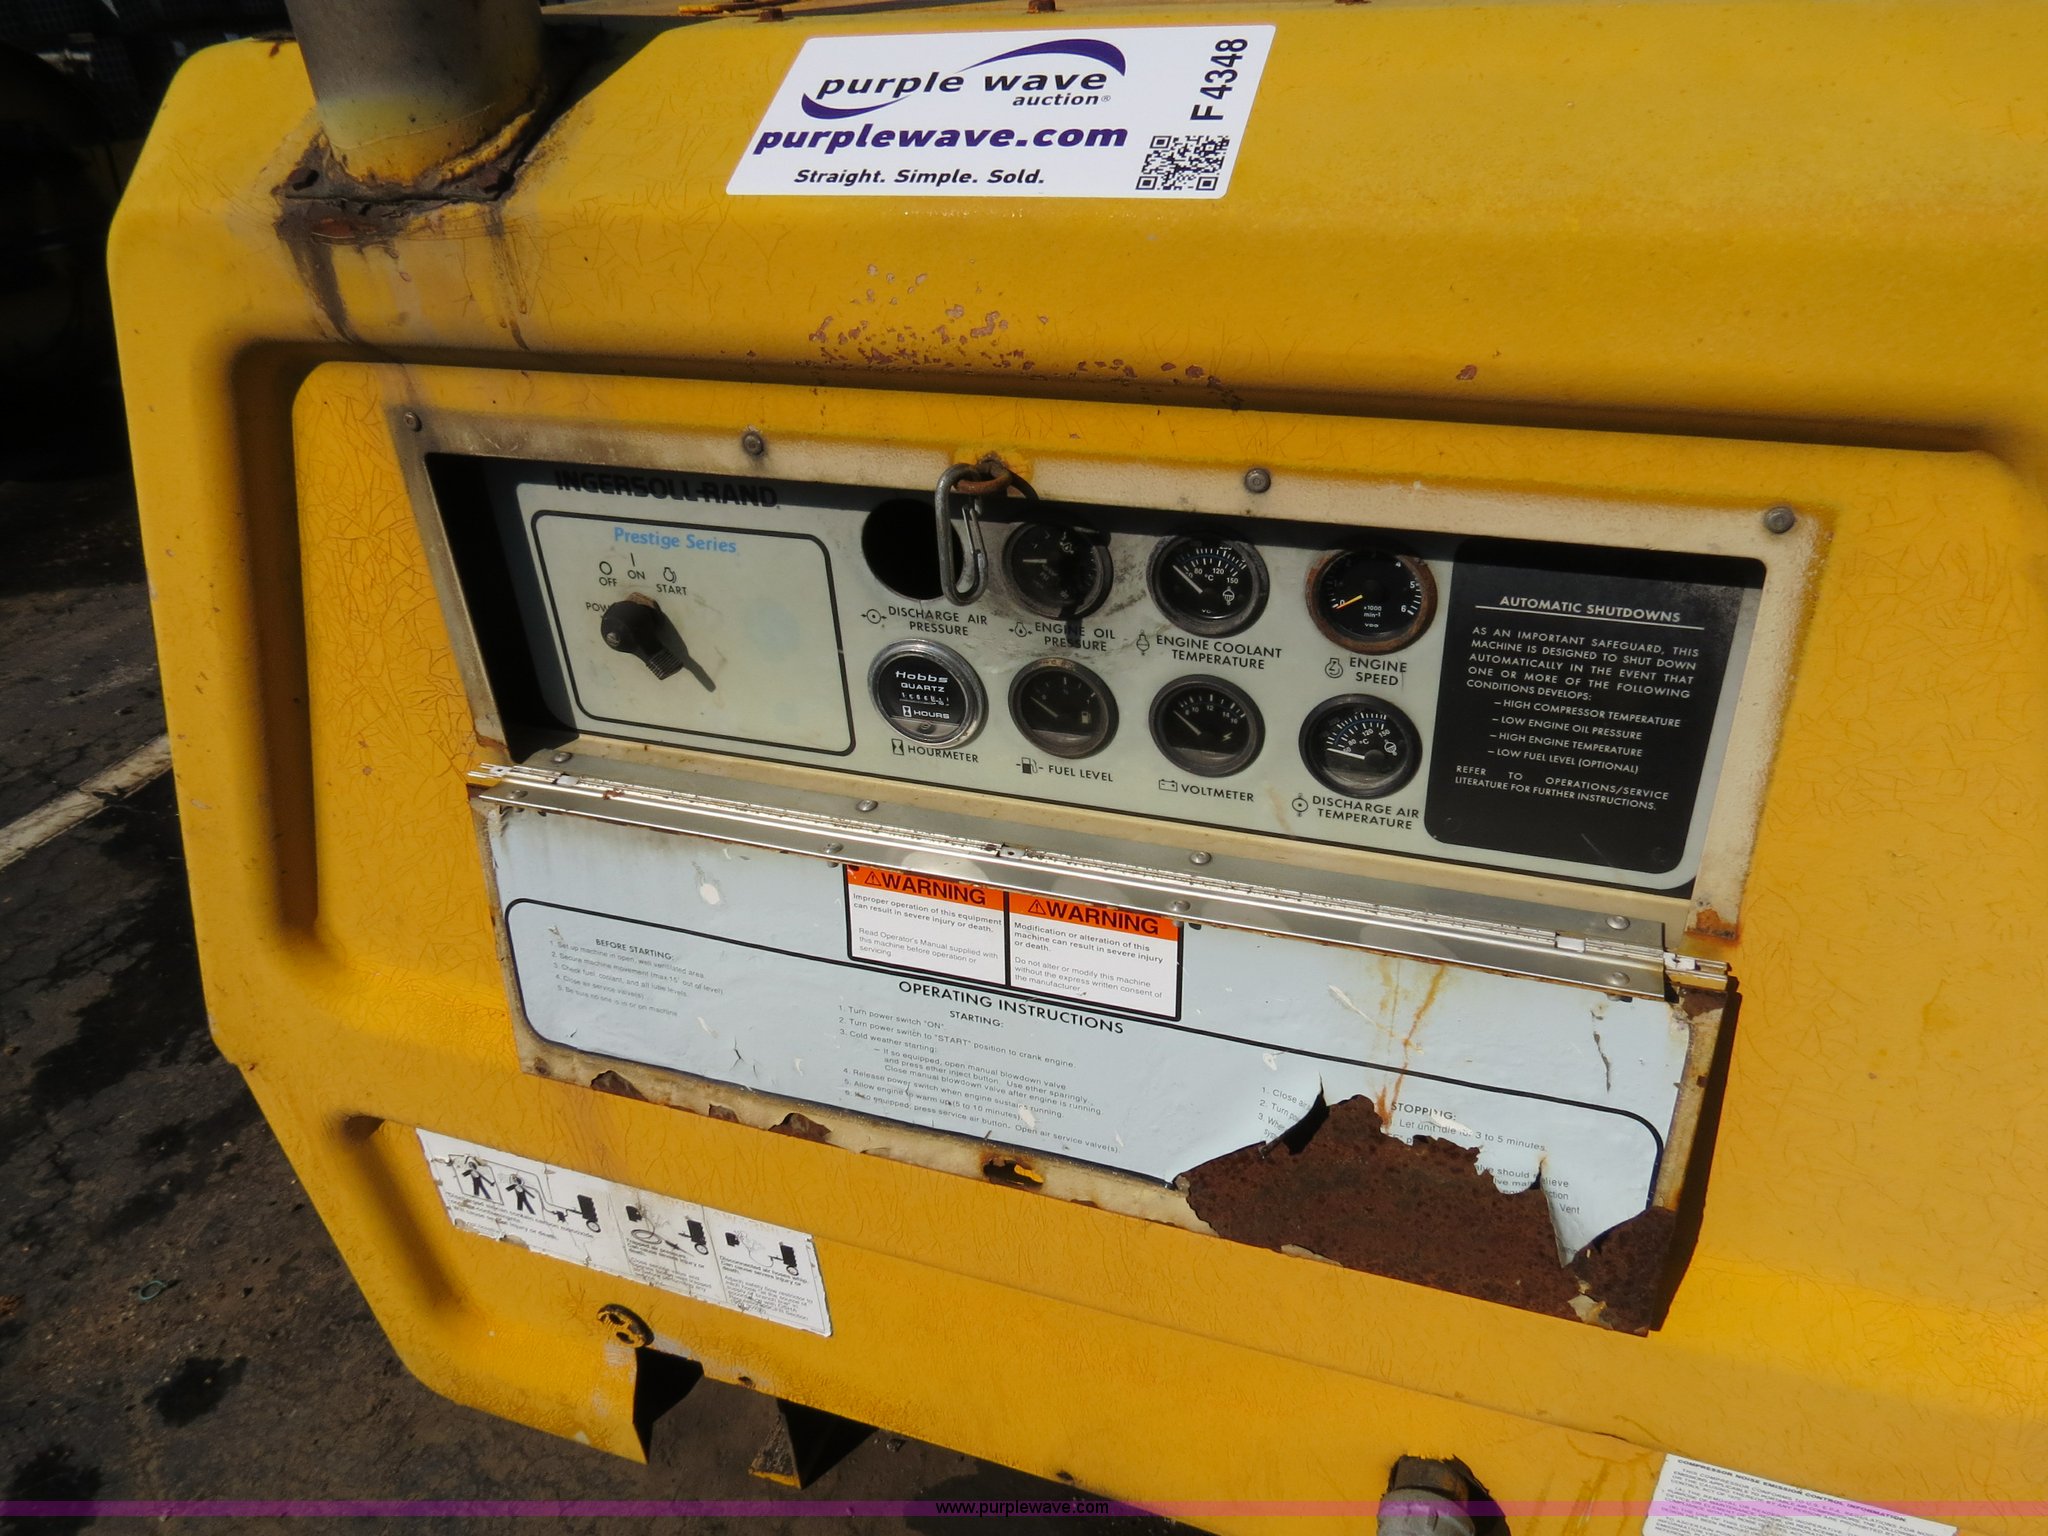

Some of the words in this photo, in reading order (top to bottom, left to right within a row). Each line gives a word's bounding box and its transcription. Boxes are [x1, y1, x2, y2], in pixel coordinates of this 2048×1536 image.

[816, 71, 964, 101] purple
[982, 69, 1107, 92] wave
[1190, 104, 1224, 121] F
[1208, 37, 1249, 100] 4348
[752, 123, 1128, 155] purplewave.com
[794, 169, 886, 187] Straight.
[893, 168, 978, 187] Simple.
[986, 169, 1045, 184] Sold.
[614, 526, 680, 550] Prestige
[686, 531, 737, 553] Series
[599, 576, 617, 588] OFF
[627, 569, 645, 580] ON
[656, 583, 687, 596] START
[888, 605, 959, 623] DISCHARGE
[967, 613, 987, 626] AIR
[1499, 596, 1582, 613] AUTOMATIC
[1587, 604, 1680, 622] SHUTDOWNS
[909, 621, 969, 636] PRESSURE
[1035, 622, 1086, 638] ENGINE
[1094, 627, 1116, 639] OIL
[1044, 636, 1107, 651] PRESSURE
[1157, 635, 1210, 650] ENGINE
[1214, 641, 1282, 658] COOLANT
[1472, 627, 1487, 635] AS
[1493, 629, 1511, 637] AN
[1517, 631, 1585, 645] IMPORTANT
[1591, 639, 1664, 655] SAFEGUARD,
[1673, 647, 1699, 657] THIS
[1172, 649, 1265, 670] TEMPERATURE
[1350, 657, 1408, 673] ENGINE
[1471, 640, 1522, 652] MACHINE
[1527, 645, 1537, 653] IS
[1542, 647, 1597, 660] DESIGNED
[1603, 653, 1617, 662] TO
[1623, 655, 1652, 665] SHUT
[1657, 659, 1696, 670] DOWN
[895, 670, 948, 683] Hobbs
[1356, 671, 1399, 686] SPEED
[1469, 653, 1563, 670] AUTOMATICALLY
[1570, 664, 1583, 672] IN
[1591, 666, 1612, 676] THE
[1619, 669, 1656, 680] EVENT
[1664, 674, 1694, 684] THAT
[901, 682, 944, 693] QUARTZ
[1467, 679, 1535, 694] CONDITIONS
[1537, 687, 1592, 701] DEVELOPS:
[1468, 666, 1493, 676] ONE
[1501, 670, 1517, 679] OR
[1524, 673, 1558, 683] MORE
[1565, 677, 1581, 685] OF
[1589, 680, 1610, 689] THE
[1617, 683, 1690, 698] FOLLOWING
[914, 710, 949, 719] HOURS
[1533, 703, 1605, 718] COMPRESSOR
[1608, 712, 1681, 727] TEMPERATURE
[1528, 719, 1569, 731] ENGINE
[1572, 724, 1589, 734] OIL
[1592, 727, 1642, 740] PRESSURE
[907, 744, 978, 763] HOURMETER
[1529, 736, 1569, 748] ENGINE
[1572, 741, 1643, 757] TEMPERATURE
[1048, 764, 1076, 777] FUEL
[1080, 769, 1113, 782] LEVEL
[1523, 752, 1547, 761] FUEL
[1549, 755, 1575, 765] LEVEL
[1578, 759, 1639, 775] (OPTIONAL)
[1181, 784, 1254, 802] VOLTMETER
[1455, 777, 1508, 790] LITERATURE
[1510, 784, 1530, 793] FOR
[1533, 787, 1575, 799] FURTHER
[1578, 793, 1656, 810] INSTRUCTIONS.
[1456, 765, 1487, 775] REFER
[1508, 772, 1523, 780] TO
[1545, 777, 1669, 800] OPERATIONS/SERVICE
[1312, 795, 1392, 815] DISCHARGE
[1396, 807, 1419, 819] AIR
[1317, 808, 1412, 830] TEMPERATURE
[881, 873, 986, 905] WARNING
[853, 893, 889, 906] Improper
[891, 901, 928, 913] operation
[941, 909, 955, 917] this
[958, 913, 1002, 925] equipment
[870, 905, 892, 914] result
[904, 912, 930, 921] severe
[932, 916, 955, 926] injury
[968, 922, 994, 933] death.
[1045, 900, 1159, 935] WARNING
[596, 939, 626, 951] BEFORE
[1014, 922, 1066, 937] Modification
[1079, 934, 1121, 946] alteration
[1133, 943, 1150, 952] this
[1014, 932, 1049, 943] machine
[1052, 938, 1067, 946] can
[1069, 942, 1094, 951] result
[1107, 948, 1135, 958] severe
[1138, 953, 1163, 964] injury
[899, 980, 993, 1008] OPERATING
[999, 997, 1124, 1034] INSTRUCTIONS
[949, 1010, 1004, 1028] STARTING:
[850, 1019, 867, 1027] Turn
[870, 1024, 893, 1033] power
[896, 1028, 921, 1038] switch
[974, 1043, 1006, 1054] position
[1019, 1052, 1042, 1061] crank
[1400, 1120, 1415, 1128] Let
[1418, 1123, 1436, 1133] unit
[1476, 1131, 1482, 1139] 3
[1485, 1134, 1494, 1142] to
[1497, 1135, 1503, 1143] 5
[1497, 1168, 1529, 1179] should
[1559, 1203, 1580, 1214] Vent
[1678, 1459, 1733, 1476] COMPRESSOR
[1736, 1474, 1760, 1484] NOISE
[1763, 1481, 1802, 1495] EMISSION
[1805, 1492, 1843, 1505] CONTROL
[1847, 1503, 1906, 1522] INFORMATION
